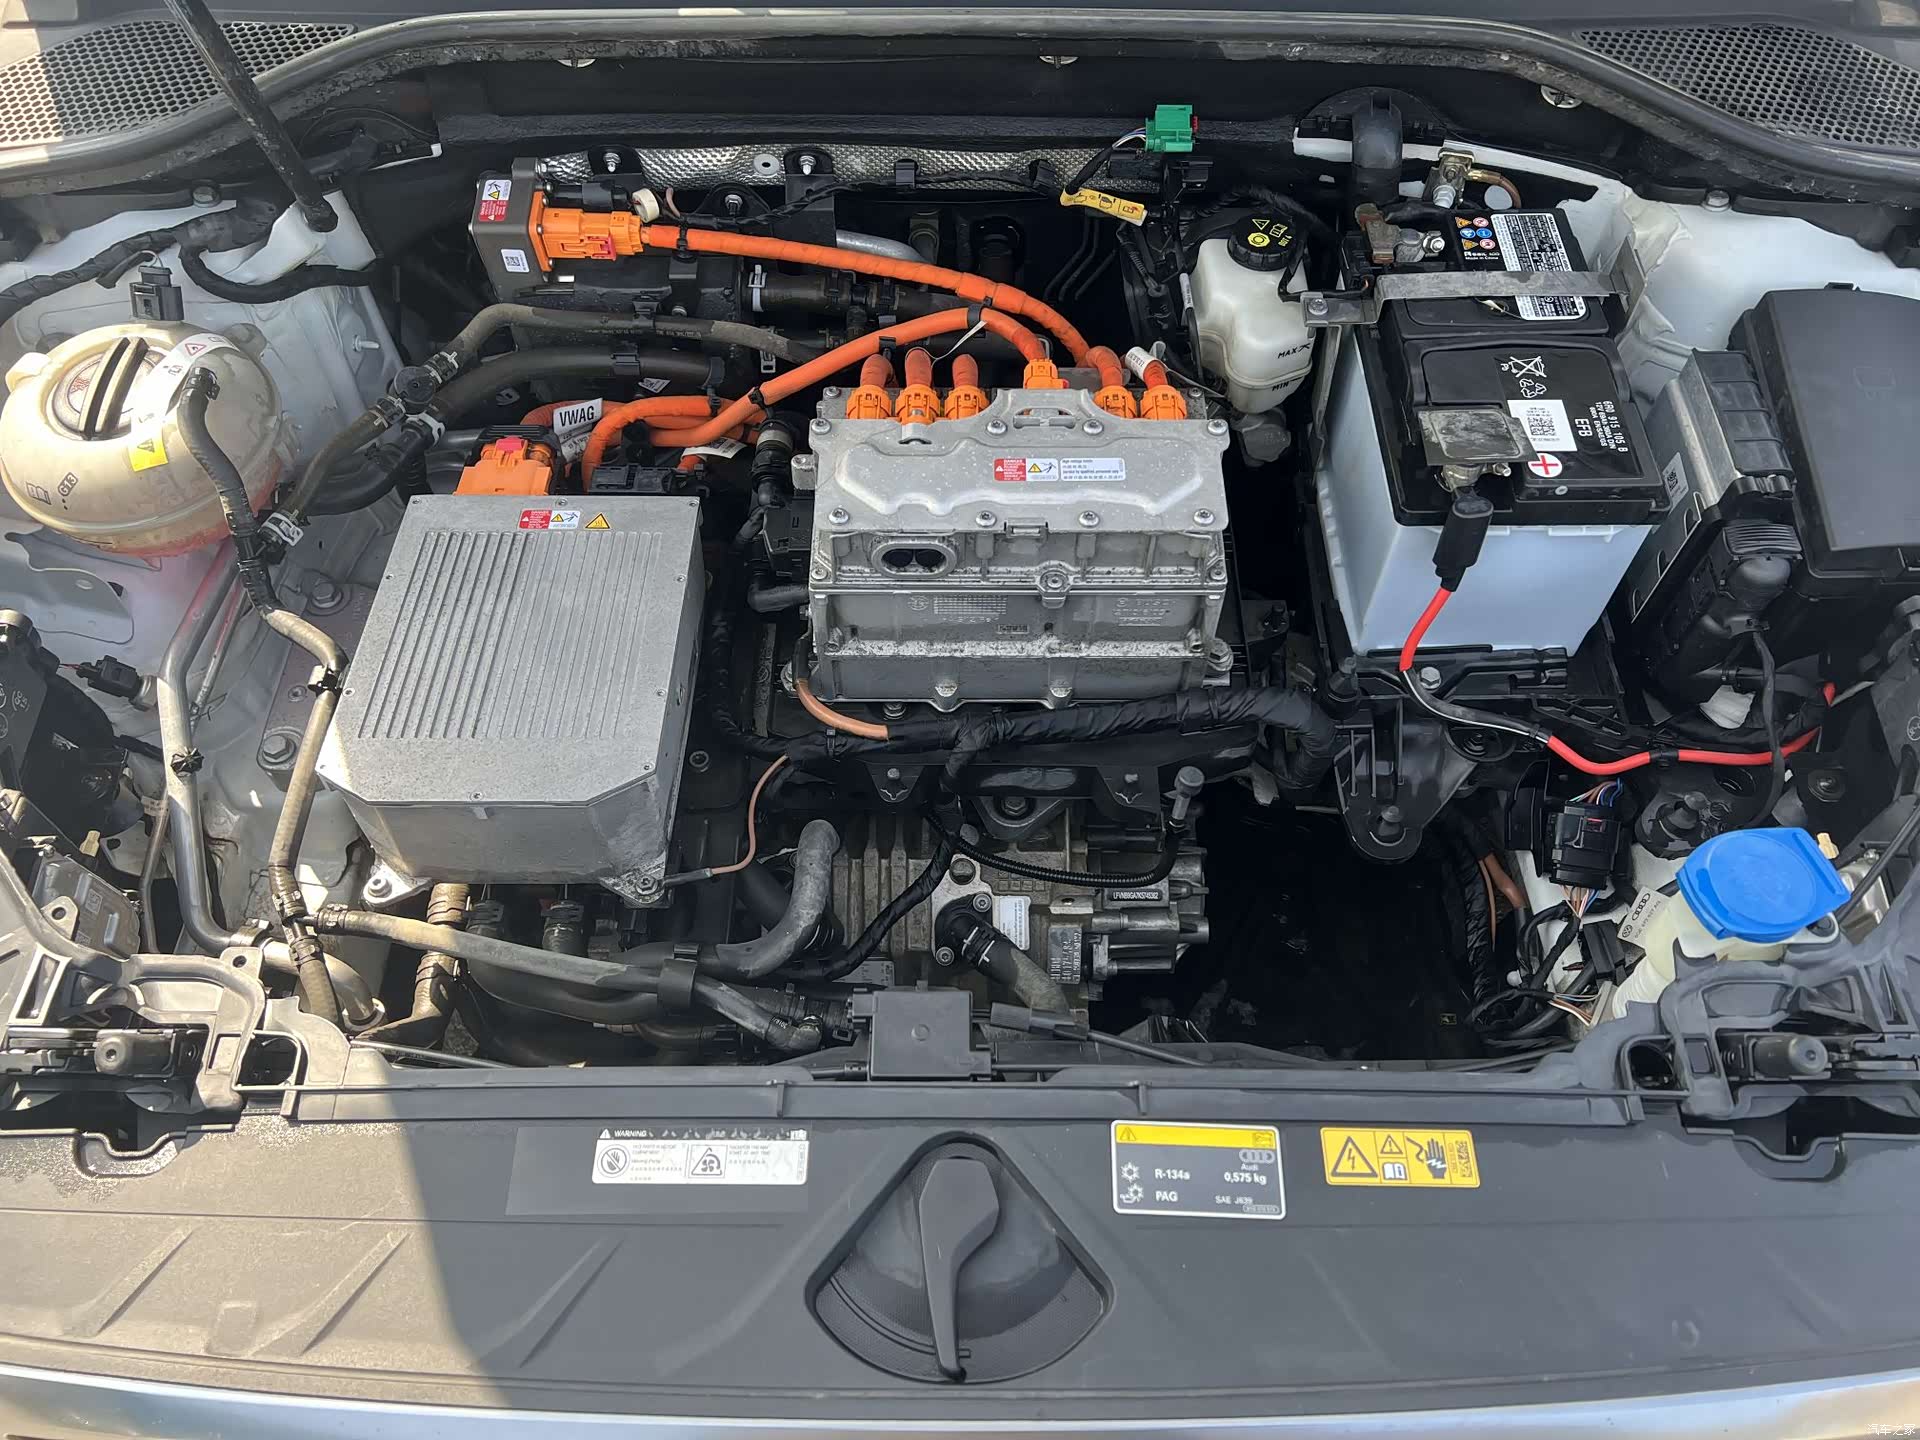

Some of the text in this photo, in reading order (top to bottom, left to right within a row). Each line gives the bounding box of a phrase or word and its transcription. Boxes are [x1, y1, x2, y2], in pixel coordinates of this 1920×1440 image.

[1278, 348, 1298, 358] MAX
[1272, 381, 1290, 392] MIN
[559, 406, 594, 427] VWAG
[1608, 416, 1620, 429] 915
[1574, 418, 1593, 437] EFB
[1613, 432, 1626, 444] 105
[59, 474, 76, 494] G13
[614, 1130, 647, 1138] WARNING
[1154, 1168, 1191, 1180] R-134a
[1241, 1164, 1258, 1172] Audi
[1224, 1172, 1267, 1185] 0,575 kg
[1156, 1190, 1178, 1202] PAG
[1215, 1195, 1232, 1205] SAE
